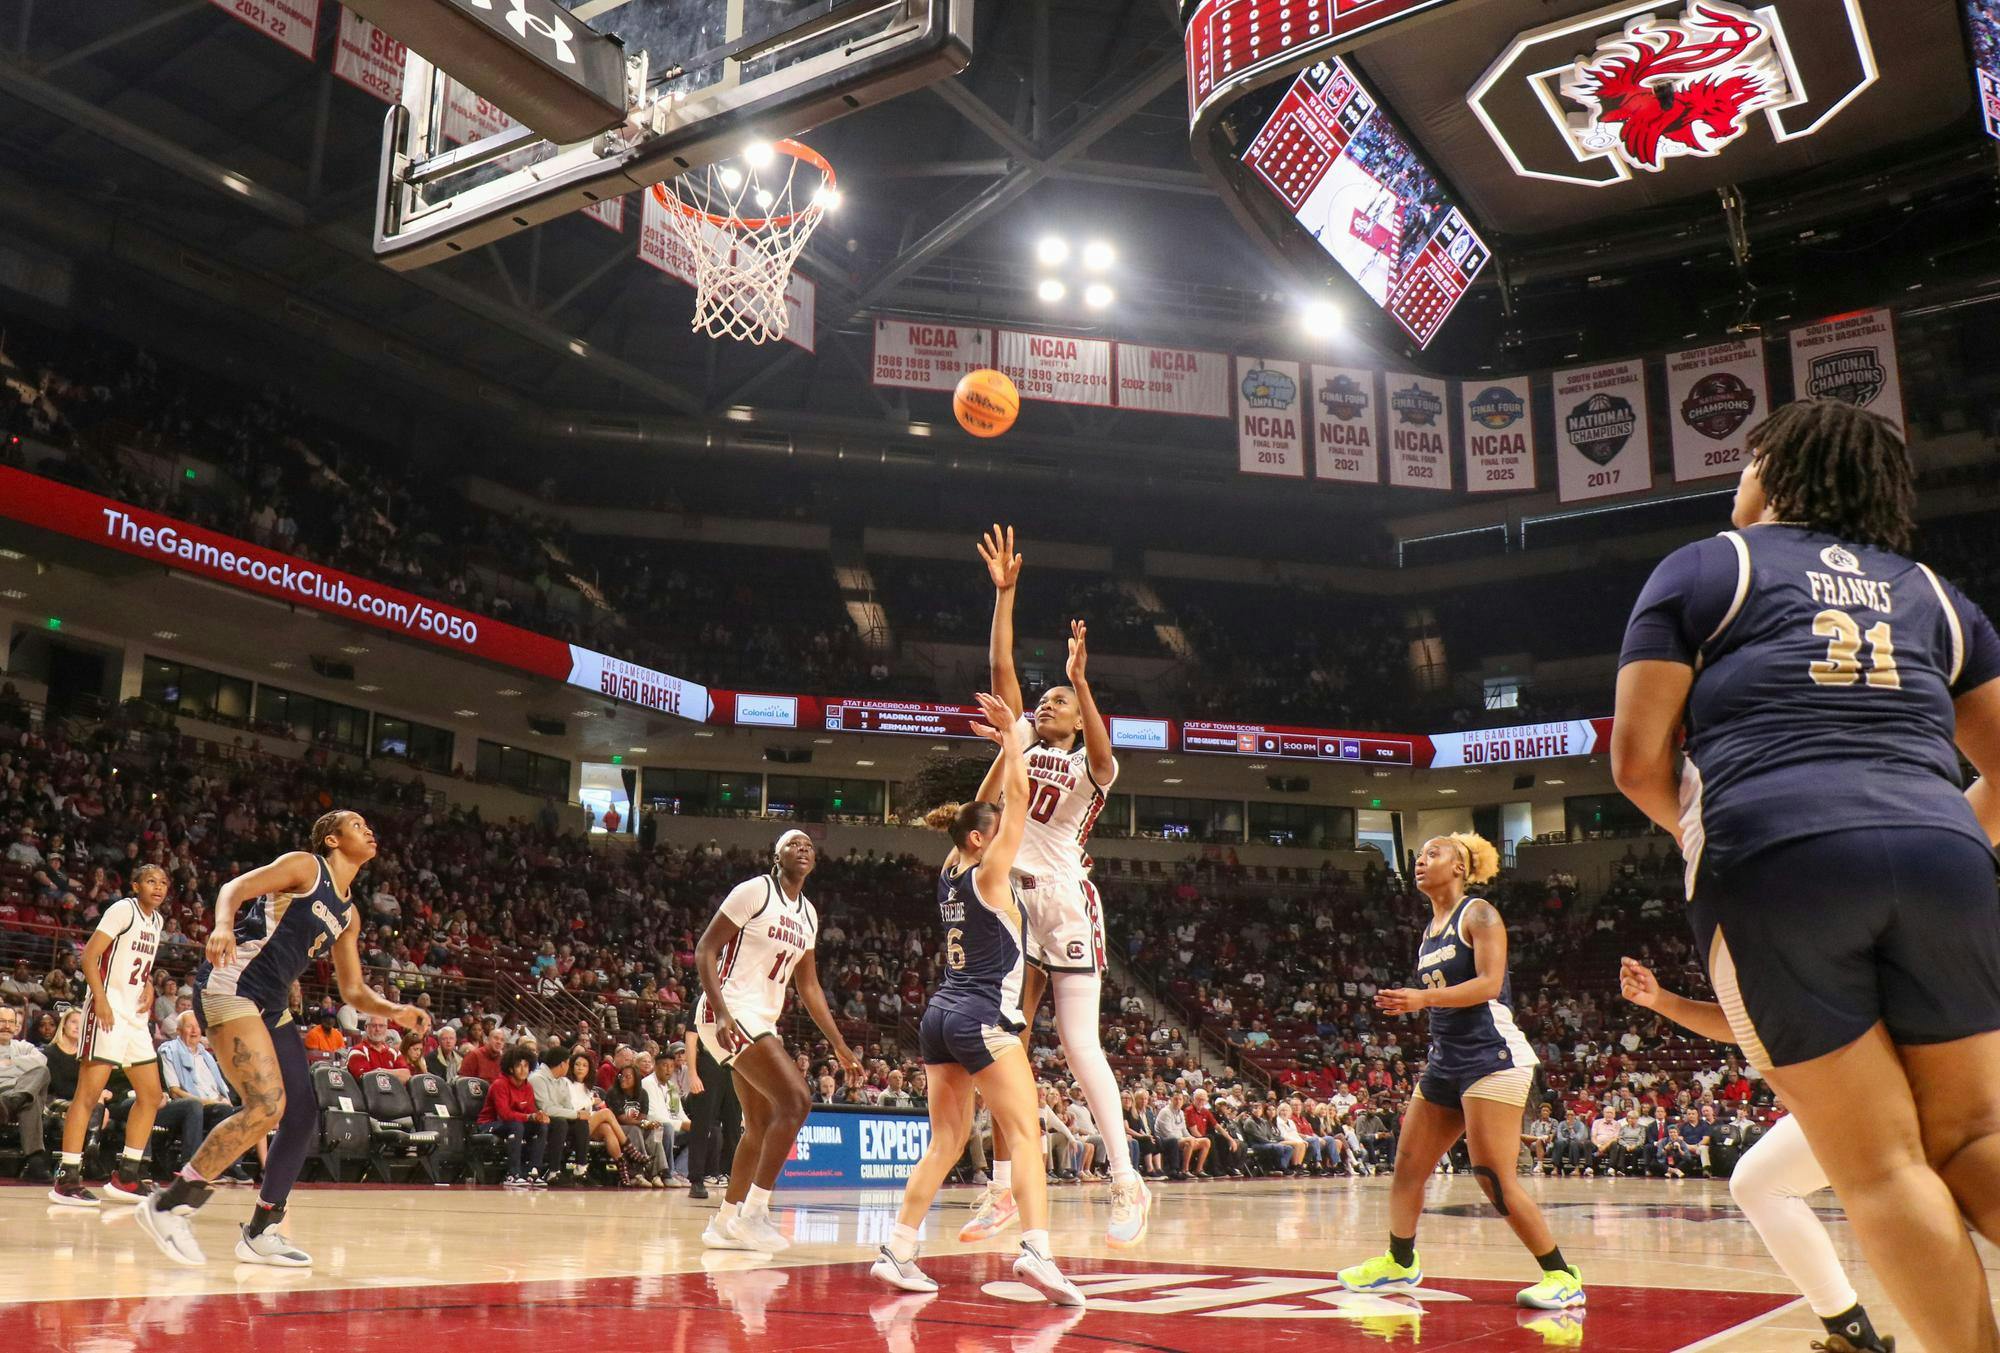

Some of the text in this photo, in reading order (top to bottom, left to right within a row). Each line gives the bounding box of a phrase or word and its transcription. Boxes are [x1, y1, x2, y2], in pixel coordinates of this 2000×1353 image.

[235, 1, 287, 37] 2021-22
[1222, 9, 1231, 20] 0
[1222, 23, 1231, 33] 0
[1249, 9, 1259, 20] 0
[1223, 35, 1231, 46] 4
[1280, 8, 1290, 20] 0
[1223, 49, 1231, 60] 2
[1250, 35, 1260, 46] 0
[1281, 21, 1291, 33] 0
[1308, 9, 1319, 21] 0
[371, 28, 407, 68] SEC
[1223, 62, 1232, 73] 4
[1252, 48, 1259, 59] 1
[1281, 34, 1291, 46] 0
[1309, 23, 1320, 34] 0
[362, 70, 402, 101] 2022-2
[1796, 323, 1887, 348] WOMEN'S BASKETBALL
[1806, 315, 1874, 337] SOUTH CAROLINA
[909, 326, 959, 348] NCAA
[1030, 337, 1078, 361] NCAA
[1680, 349, 1706, 361] SOUTH
[877, 354, 903, 367] 1986
[906, 357, 931, 370] 1988
[935, 360, 961, 372] 1989
[1150, 350, 1198, 373] NCAA
[1671, 349, 1757, 372] WOMEN'S BASKETBALL
[1814, 355, 1873, 379] NATIONAL
[876, 367, 931, 382] 2003 2013
[1028, 369, 1052, 381] 1990
[1056, 372, 1081, 384] 2012
[1083, 375, 1107, 387] 2014
[1121, 378, 1145, 391] 2002
[1558, 374, 1639, 395] WOMEN'S BASKETBALL
[1567, 365, 1629, 385] SOUTH CAROLINA
[1811, 369, 1881, 393] CHAMPIONS
[1393, 398, 1441, 413] FINAL FOUR
[1472, 403, 1521, 415] FINAL FOUR
[1688, 400, 1749, 419] CHAMPIONS
[1244, 415, 1296, 440] NCAA
[1569, 408, 1633, 431] NATIONAL
[1320, 422, 1370, 447] NCAA
[1394, 430, 1443, 454] NCAA
[1572, 422, 1631, 443] CHAMPIONS
[1253, 440, 1289, 450] FINAL FOUR
[1329, 446, 1364, 457] FINAL FOUR
[1471, 433, 1526, 457] NCAA
[1258, 452, 1285, 464] 2015
[1335, 459, 1359, 471] 2021
[1402, 454, 1437, 464] FINAL FOUR
[1481, 457, 1519, 466] FINAL FOUR
[1704, 448, 1740, 466] 2022
[1408, 465, 1433, 478] 2023
[1486, 469, 1515, 481] 2025
[1587, 470, 1620, 487] 2017
[103, 507, 478, 644] TheGamecockClub.com/5050
[1805, 570, 1892, 614] FRANKS
[1808, 608, 1903, 691] 31
[601, 656, 682, 692] THE GAMECOCK CLUB
[601, 669, 681, 715] 50/50 RAFFLE
[742, 708, 789, 719] Colonial Life
[843, 699, 960, 713] STAT LEADERBOARD TODAY
[879, 712, 914, 722] MADINA
[914, 714, 939, 723] OKOT
[1213, 723, 1235, 731] TOWN
[878, 723, 920, 732] JERMANY
[920, 725, 946, 734] MAPP
[1116, 732, 1161, 742] Colonial Life
[1462, 722, 1568, 742] THE GAMECOCK CLUB
[1264, 739, 1274, 749] 0
[1283, 742, 1316, 751] 5:00 PM
[1325, 743, 1335, 753] 0
[1345, 745, 1358, 753] TCU
[1376, 749, 1394, 757] TCU
[1463, 735, 1568, 764] 50/50 RAFFLE
[1029, 754, 1070, 774] SOUTH
[940, 902, 965, 922] FREIRE
[780, 915, 803, 935] SOUTH
[947, 927, 966, 970] 6
[128, 957, 151, 985] 24
[767, 949, 794, 984] 11
[796, 1126, 842, 1144] COLUMBIA
[859, 1119, 930, 1160] EXPECT
[796, 1142, 810, 1160] SC
[860, 1164, 893, 1179] CULINARY
